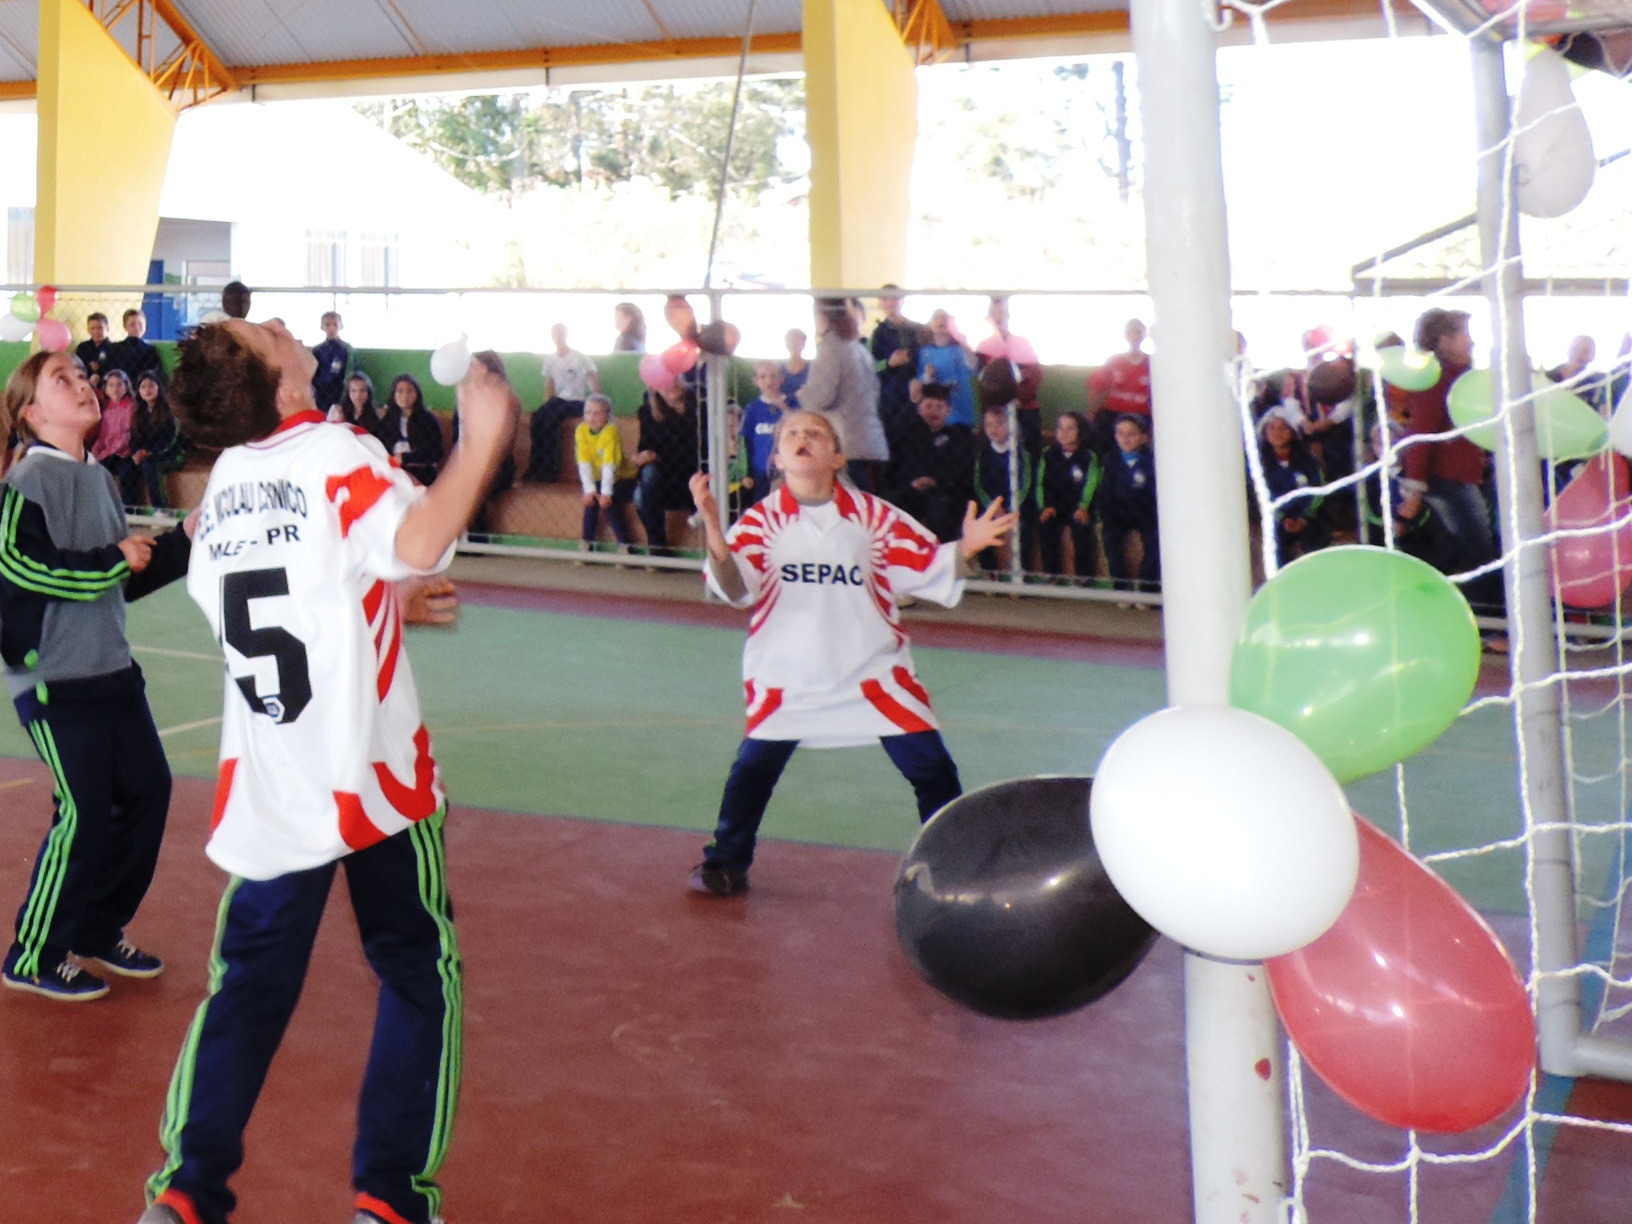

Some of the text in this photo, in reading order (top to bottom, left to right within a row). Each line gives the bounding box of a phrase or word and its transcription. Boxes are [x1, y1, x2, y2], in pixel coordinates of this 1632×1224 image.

[266, 524, 301, 545] PR
[781, 563, 864, 586] SEPAC
[222, 567, 313, 724] 5
